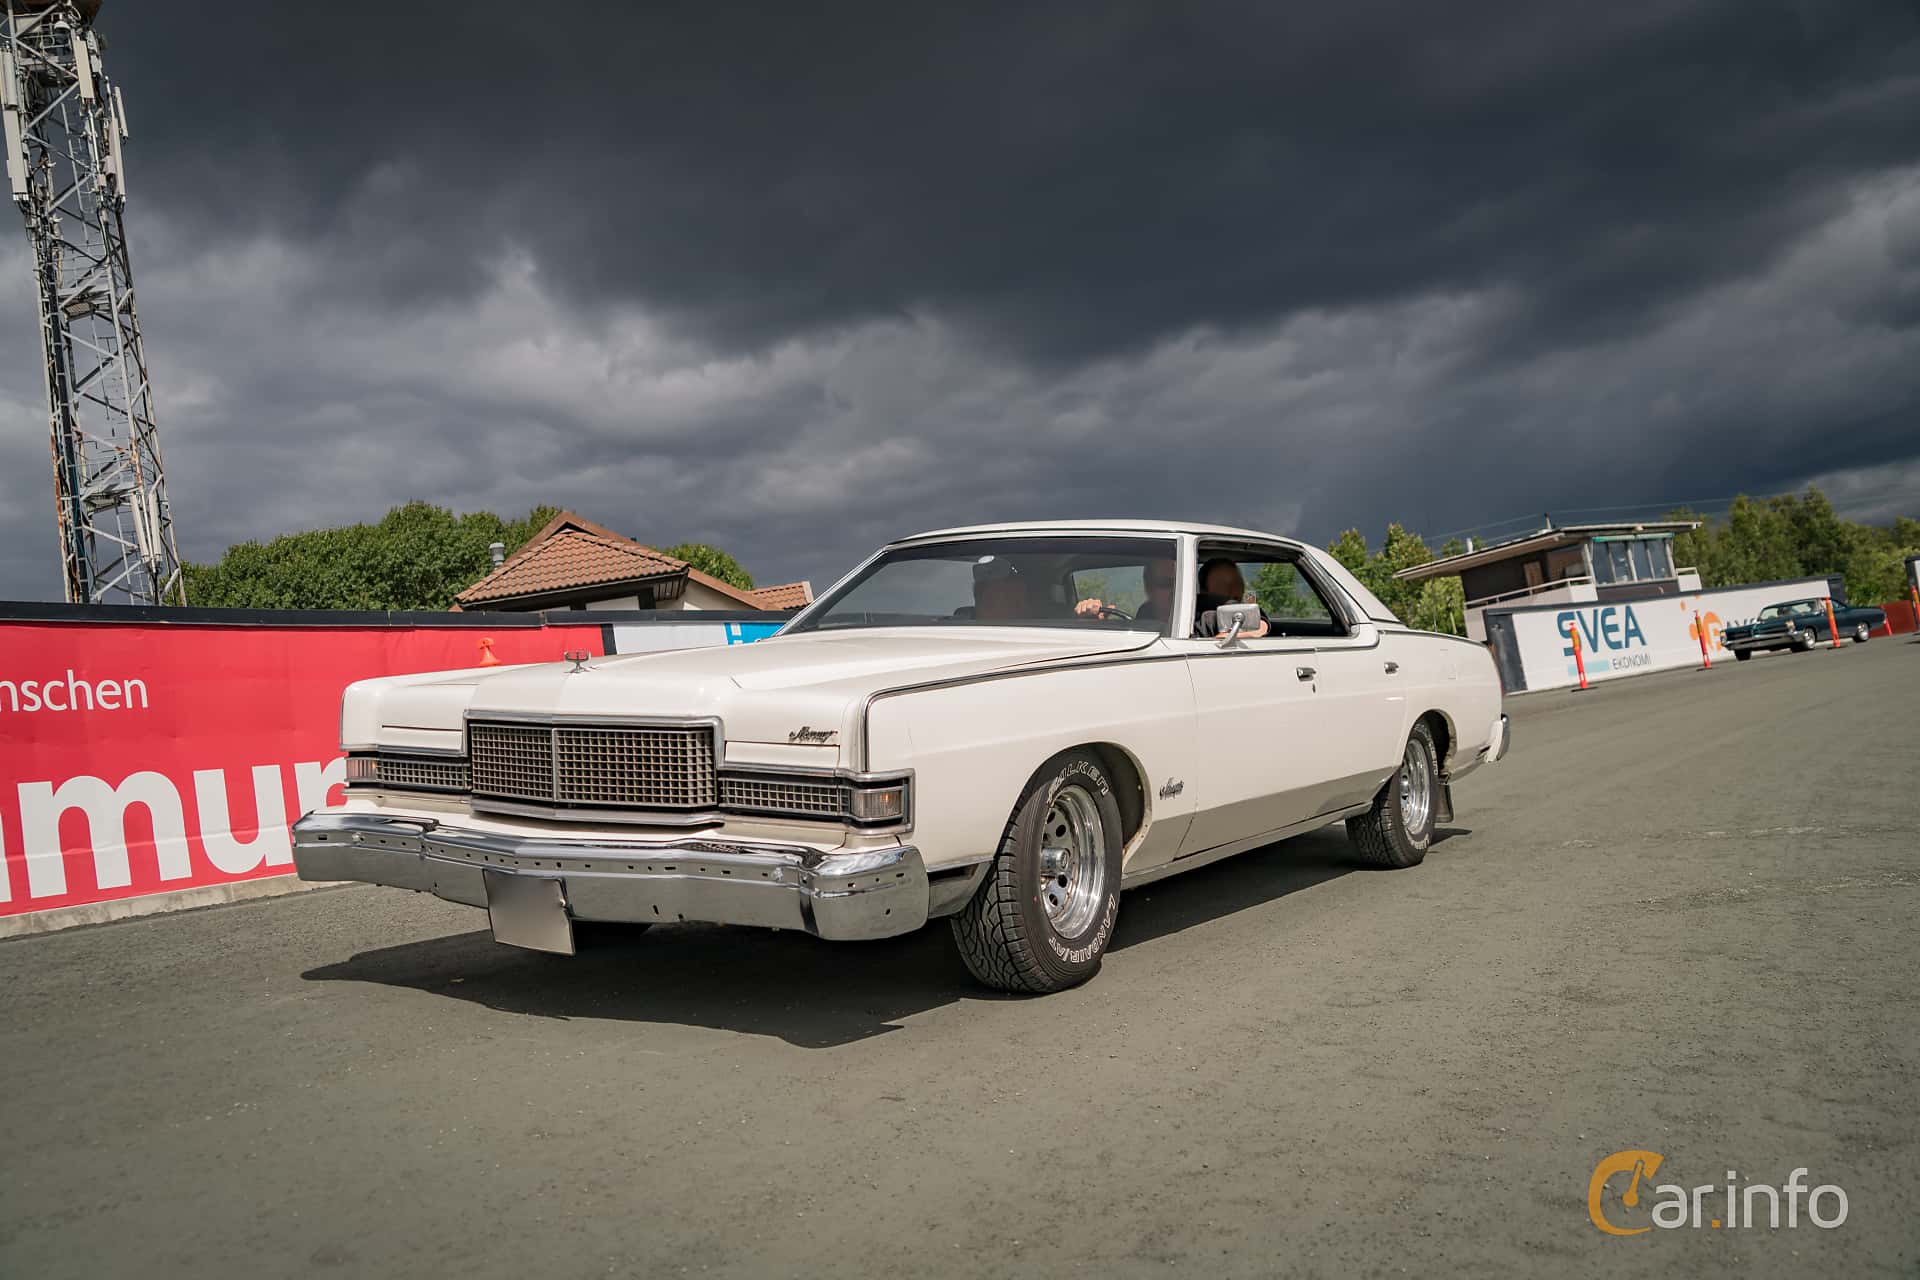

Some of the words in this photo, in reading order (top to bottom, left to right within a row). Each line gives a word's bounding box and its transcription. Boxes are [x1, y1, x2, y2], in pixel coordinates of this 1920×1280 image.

[1557, 605, 1647, 656] SVEA
[1612, 653, 1652, 670] EKONOMI
[0, 669, 148, 712] nschen
